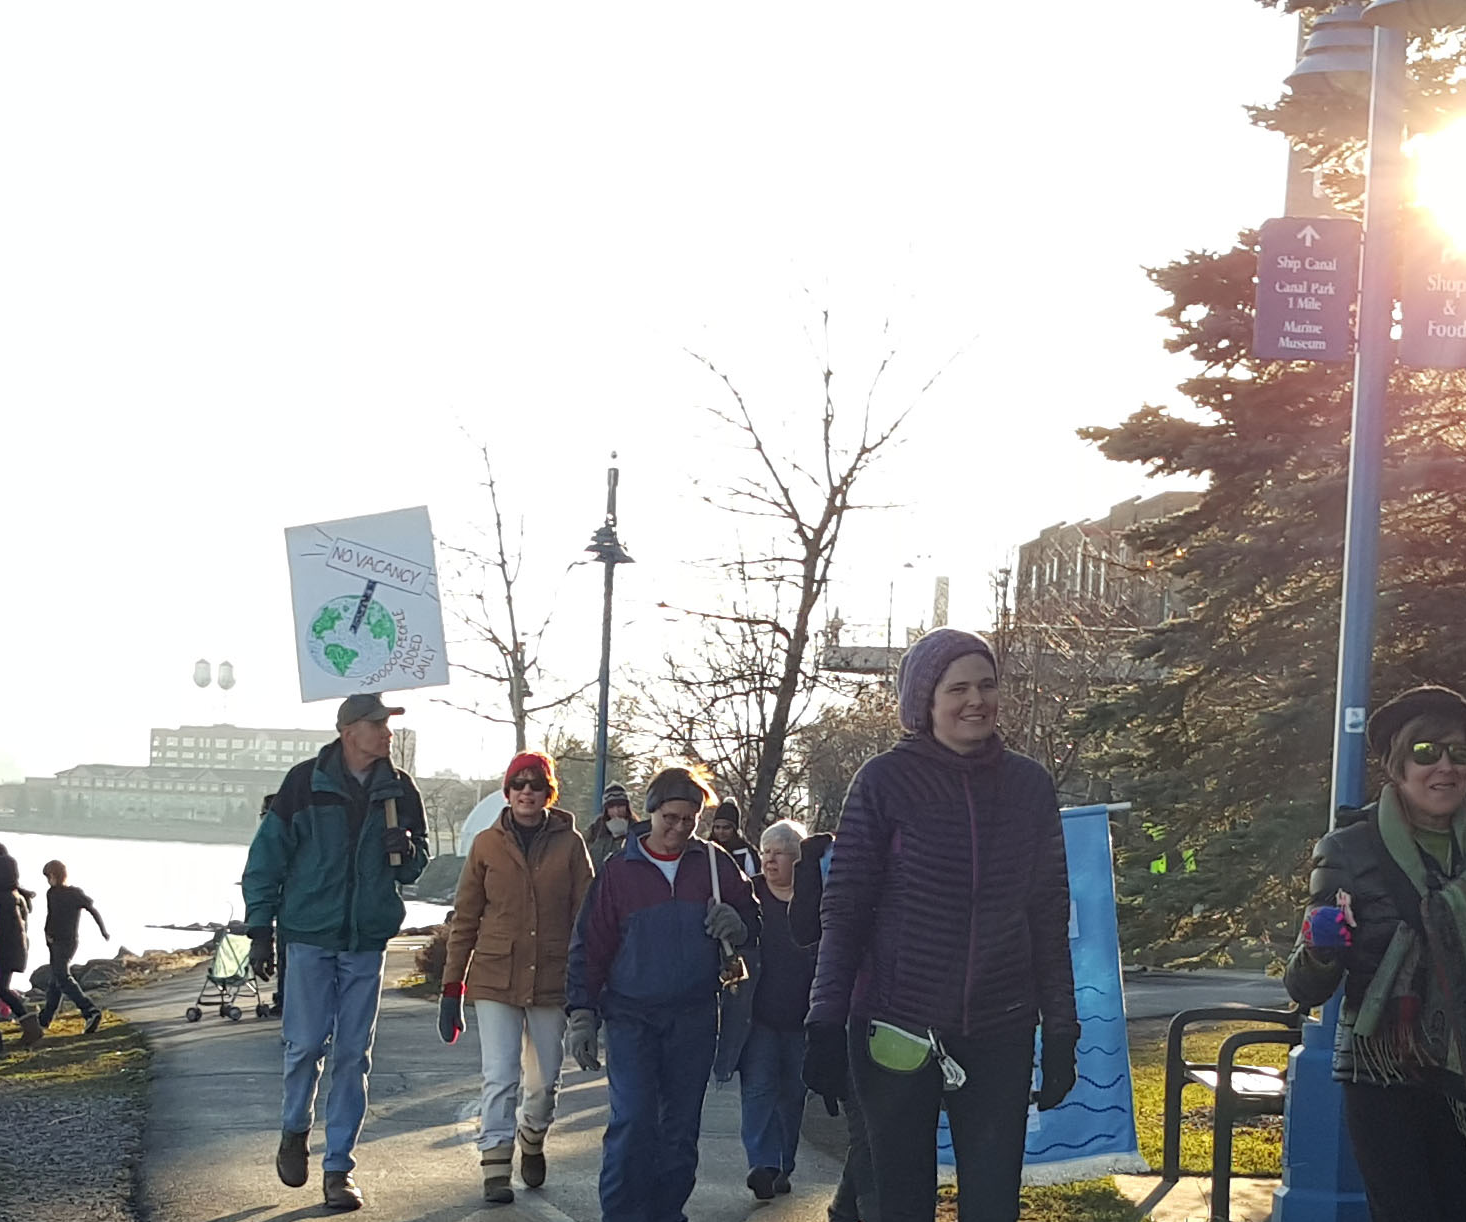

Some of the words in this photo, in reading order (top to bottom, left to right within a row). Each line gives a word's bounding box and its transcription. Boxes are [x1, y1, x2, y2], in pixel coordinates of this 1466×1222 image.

[1277, 255, 1301, 273] Ship
[1305, 257, 1337, 271] Canal
[1275, 281, 1307, 293] Canal
[1311, 282, 1336, 295] Park
[1297, 297, 1322, 310] Mile
[1443, 299, 1455, 316] &
[1283, 320, 1323, 334] Marine
[1277, 336, 1326, 350] Museum
[332, 546, 353, 563] NO
[356, 551, 421, 585] VACANCY
[392, 608, 408, 649] PEOPLE
[399, 634, 422, 674] ADDED
[413, 645, 437, 680] DAILY
